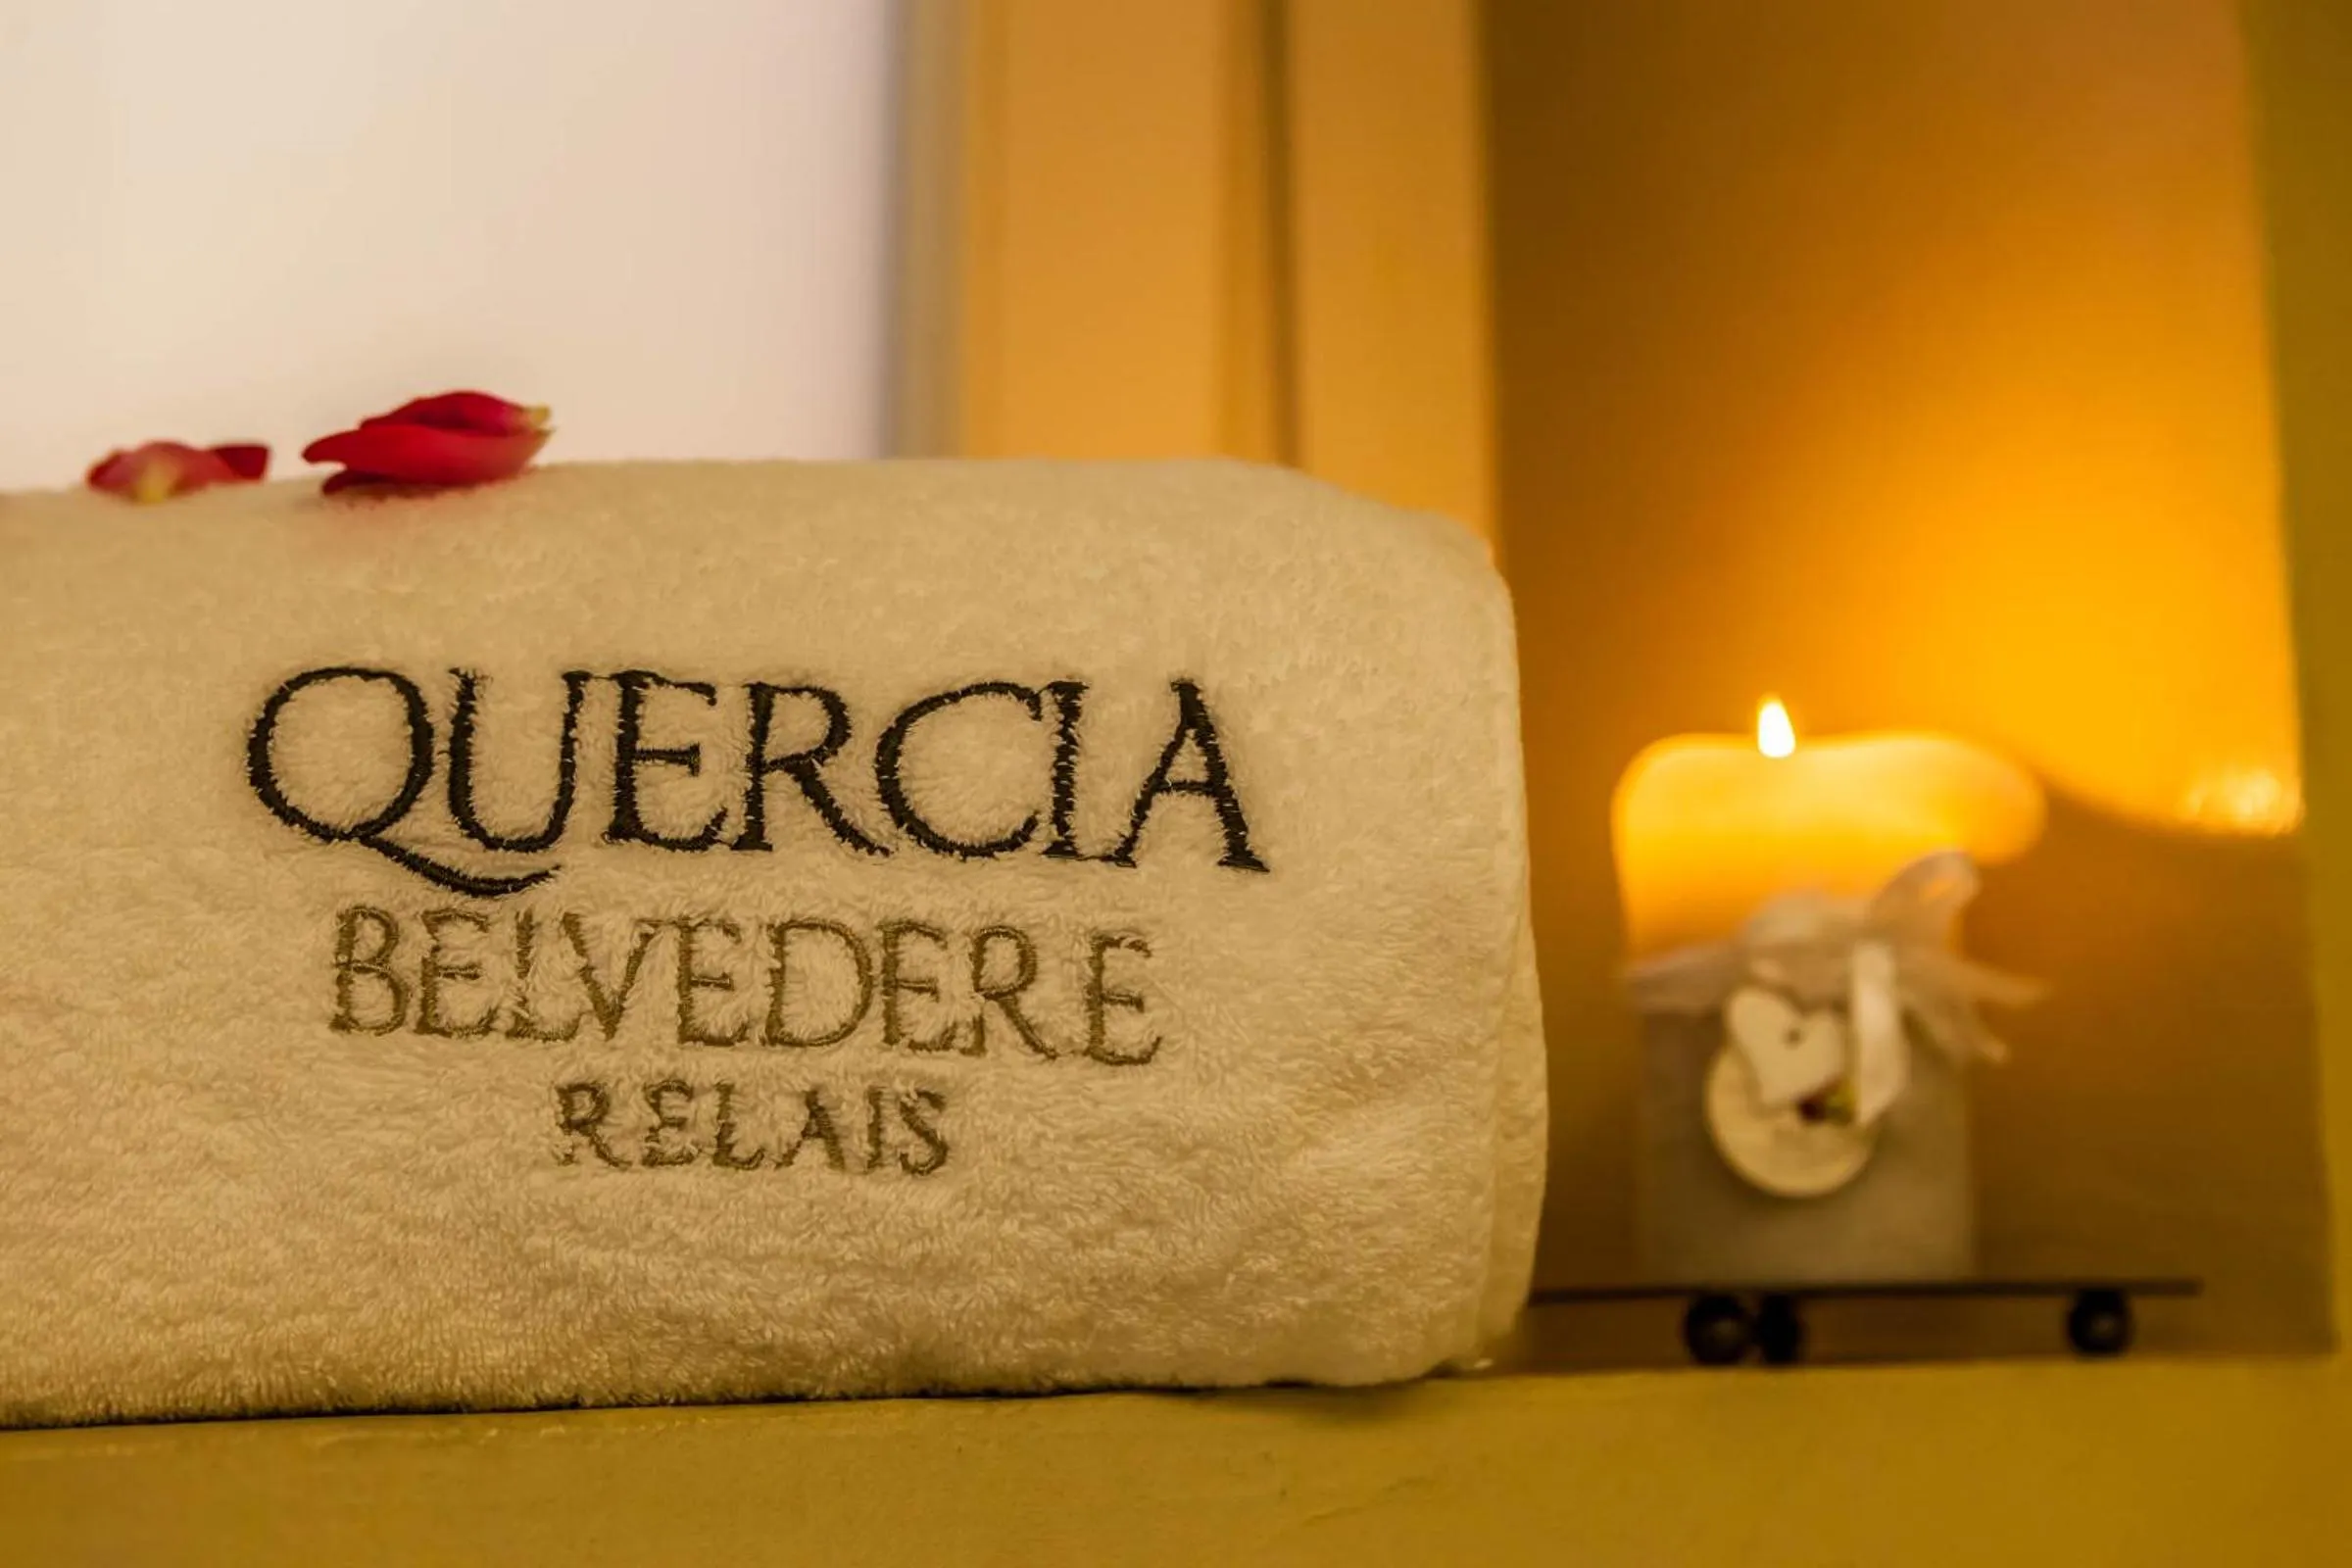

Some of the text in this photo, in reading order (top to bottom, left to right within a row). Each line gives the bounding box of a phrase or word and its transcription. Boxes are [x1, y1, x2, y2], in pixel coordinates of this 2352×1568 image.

[247, 666, 1270, 895] QUERCIA
[330, 904, 1163, 1066] BELVEDERE
[553, 1080, 950, 1176] RELAIS
